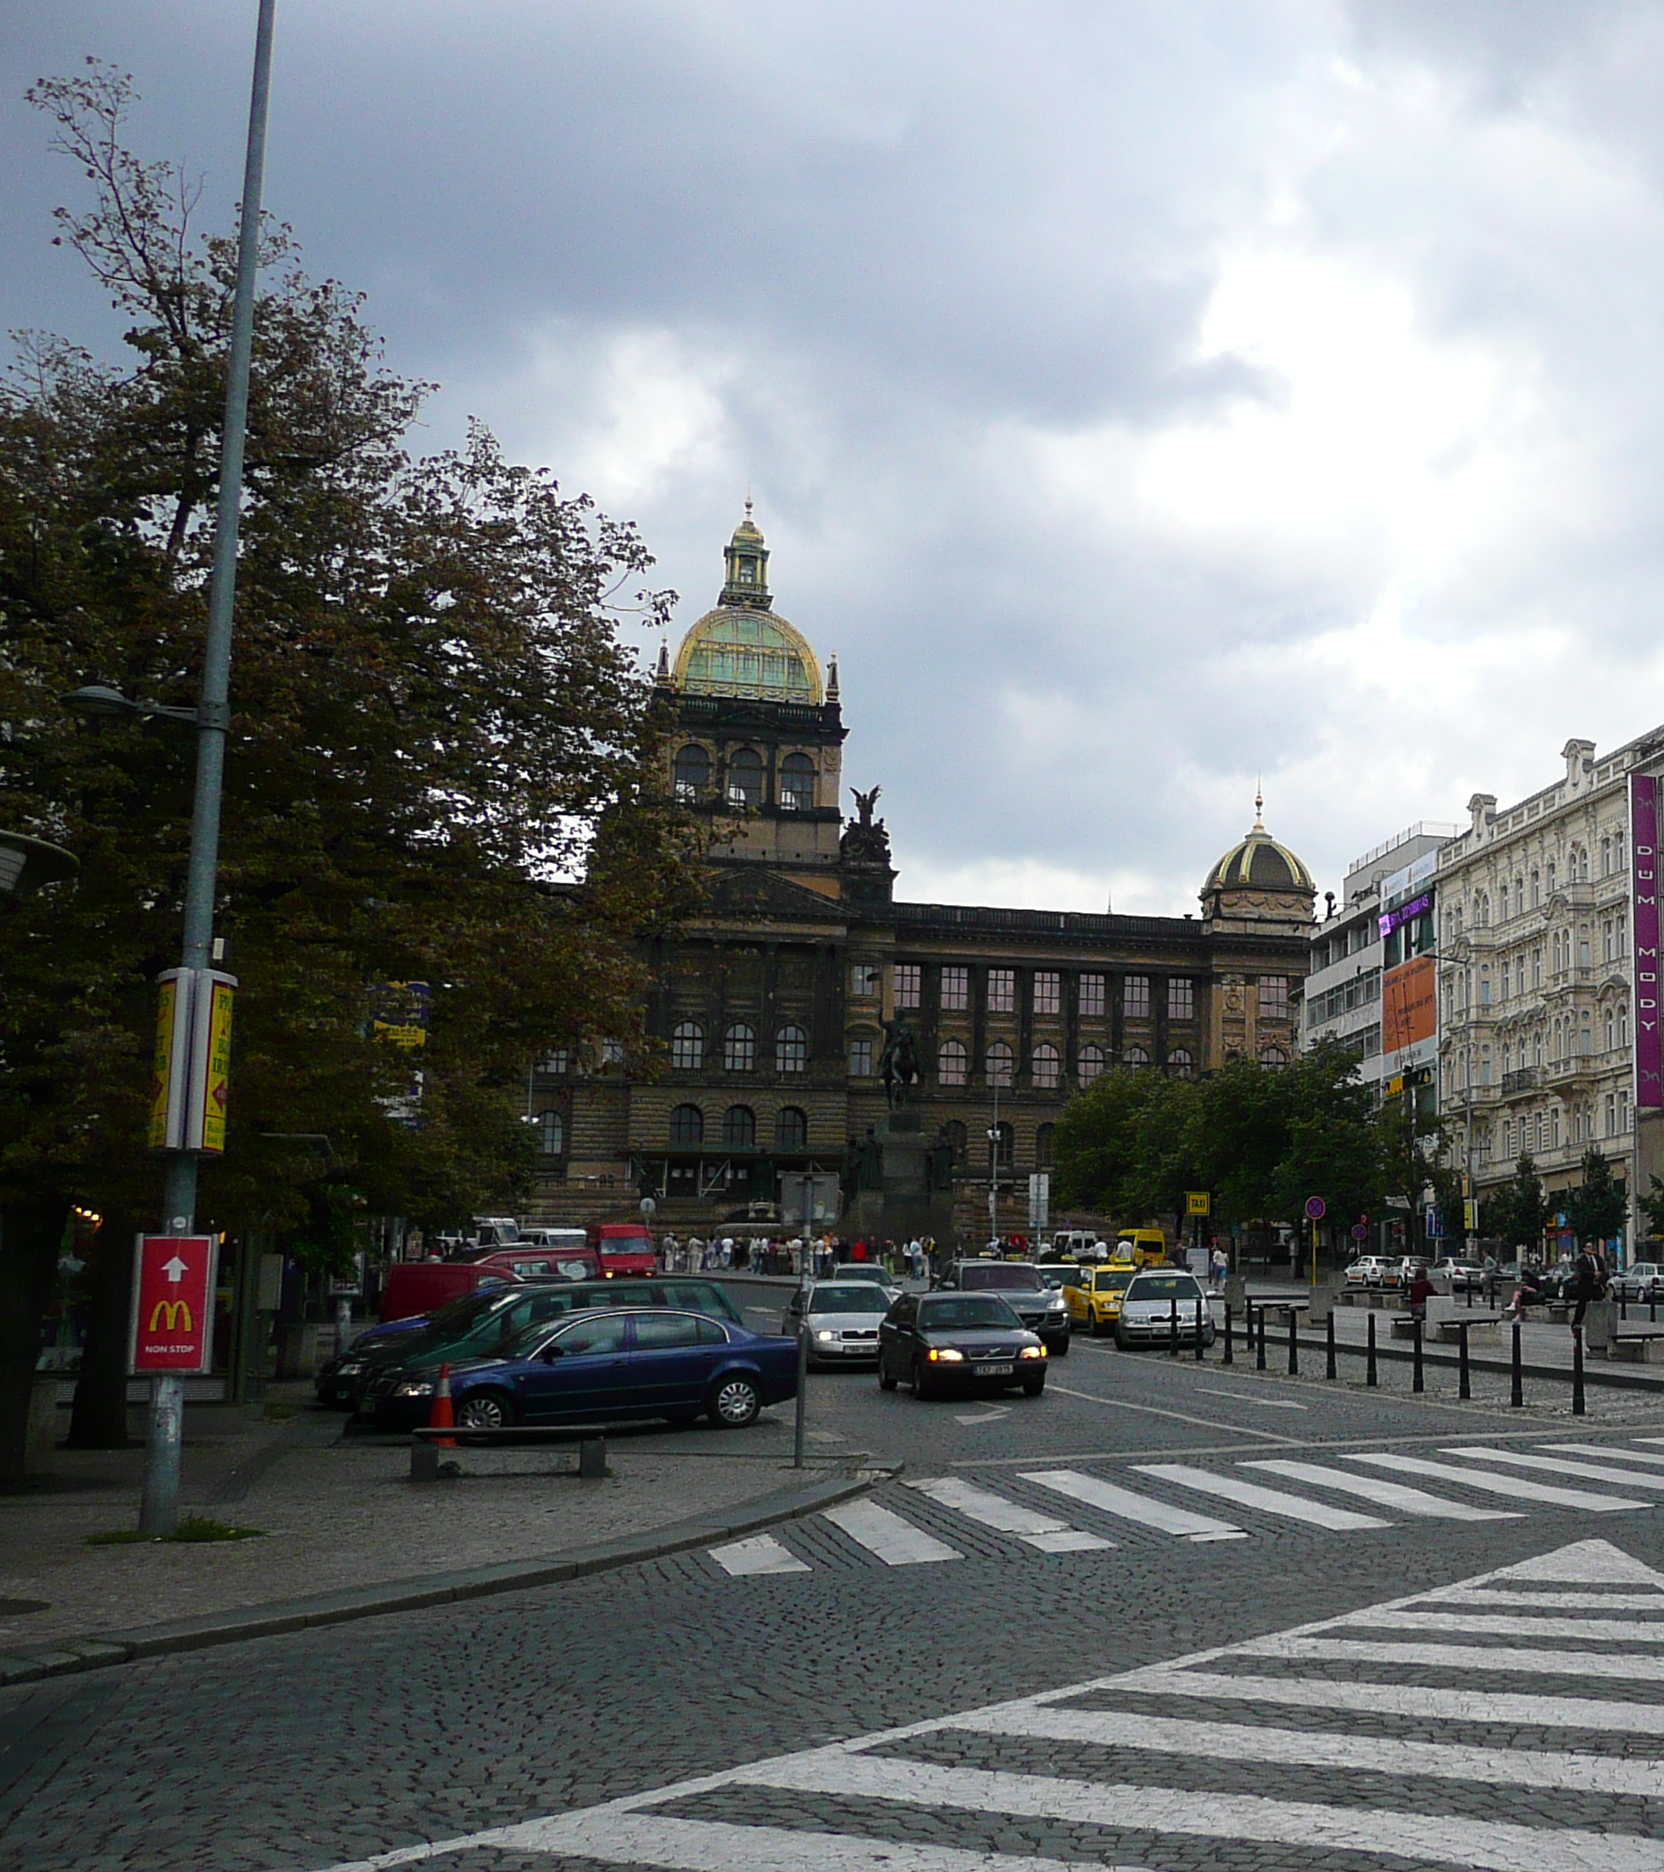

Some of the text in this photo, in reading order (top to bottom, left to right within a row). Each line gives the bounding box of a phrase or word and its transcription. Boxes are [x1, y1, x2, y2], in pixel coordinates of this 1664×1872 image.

[1191, 1198, 1206, 1209] TAXI
[145, 1345, 195, 1354] NON STOP
